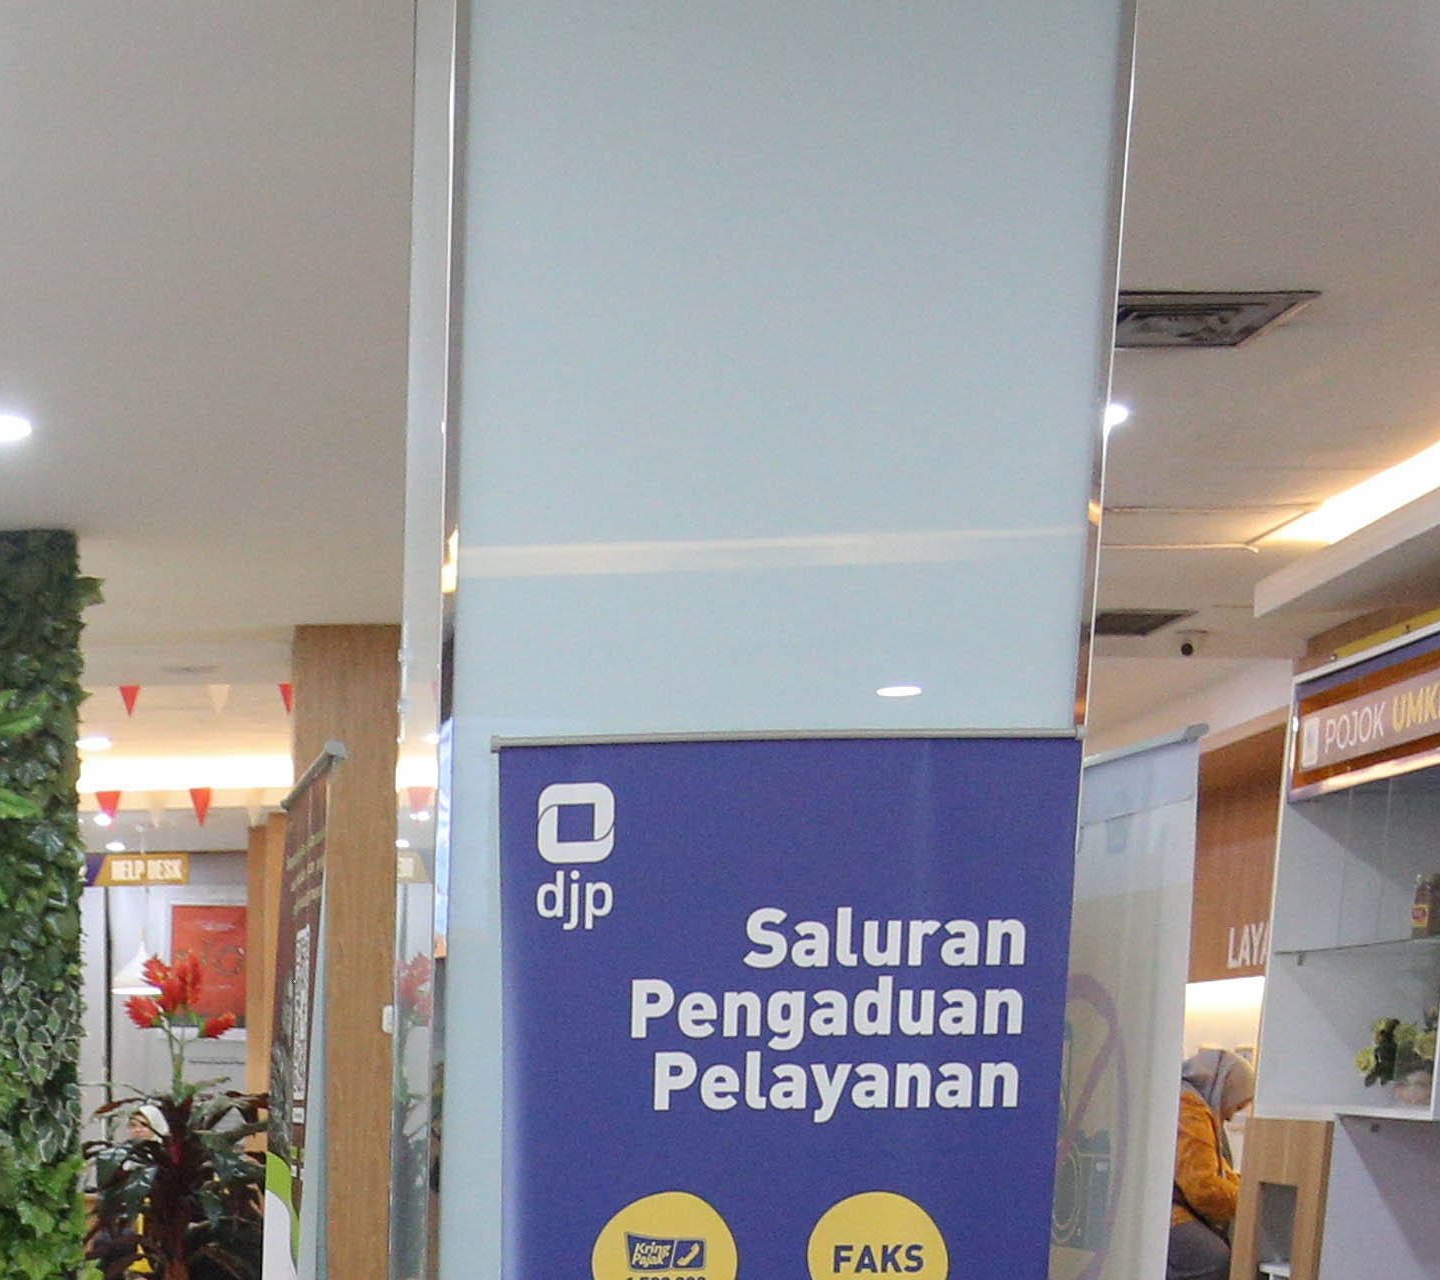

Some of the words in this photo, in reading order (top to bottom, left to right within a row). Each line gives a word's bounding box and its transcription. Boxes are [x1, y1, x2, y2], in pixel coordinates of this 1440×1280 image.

[1325, 701, 1386, 755] POJOK
[111, 860, 145, 881] HELP
[147, 859, 183, 880] DESK
[537, 870, 614, 930] djp
[743, 907, 1026, 970] Saluran
[630, 976, 1024, 1052] Pengaduan
[652, 1053, 1020, 1122] Pelayanan
[632, 1253, 664, 1268] Pajak
[634, 1242, 671, 1257] Kring
[833, 1244, 924, 1274] FAKS
